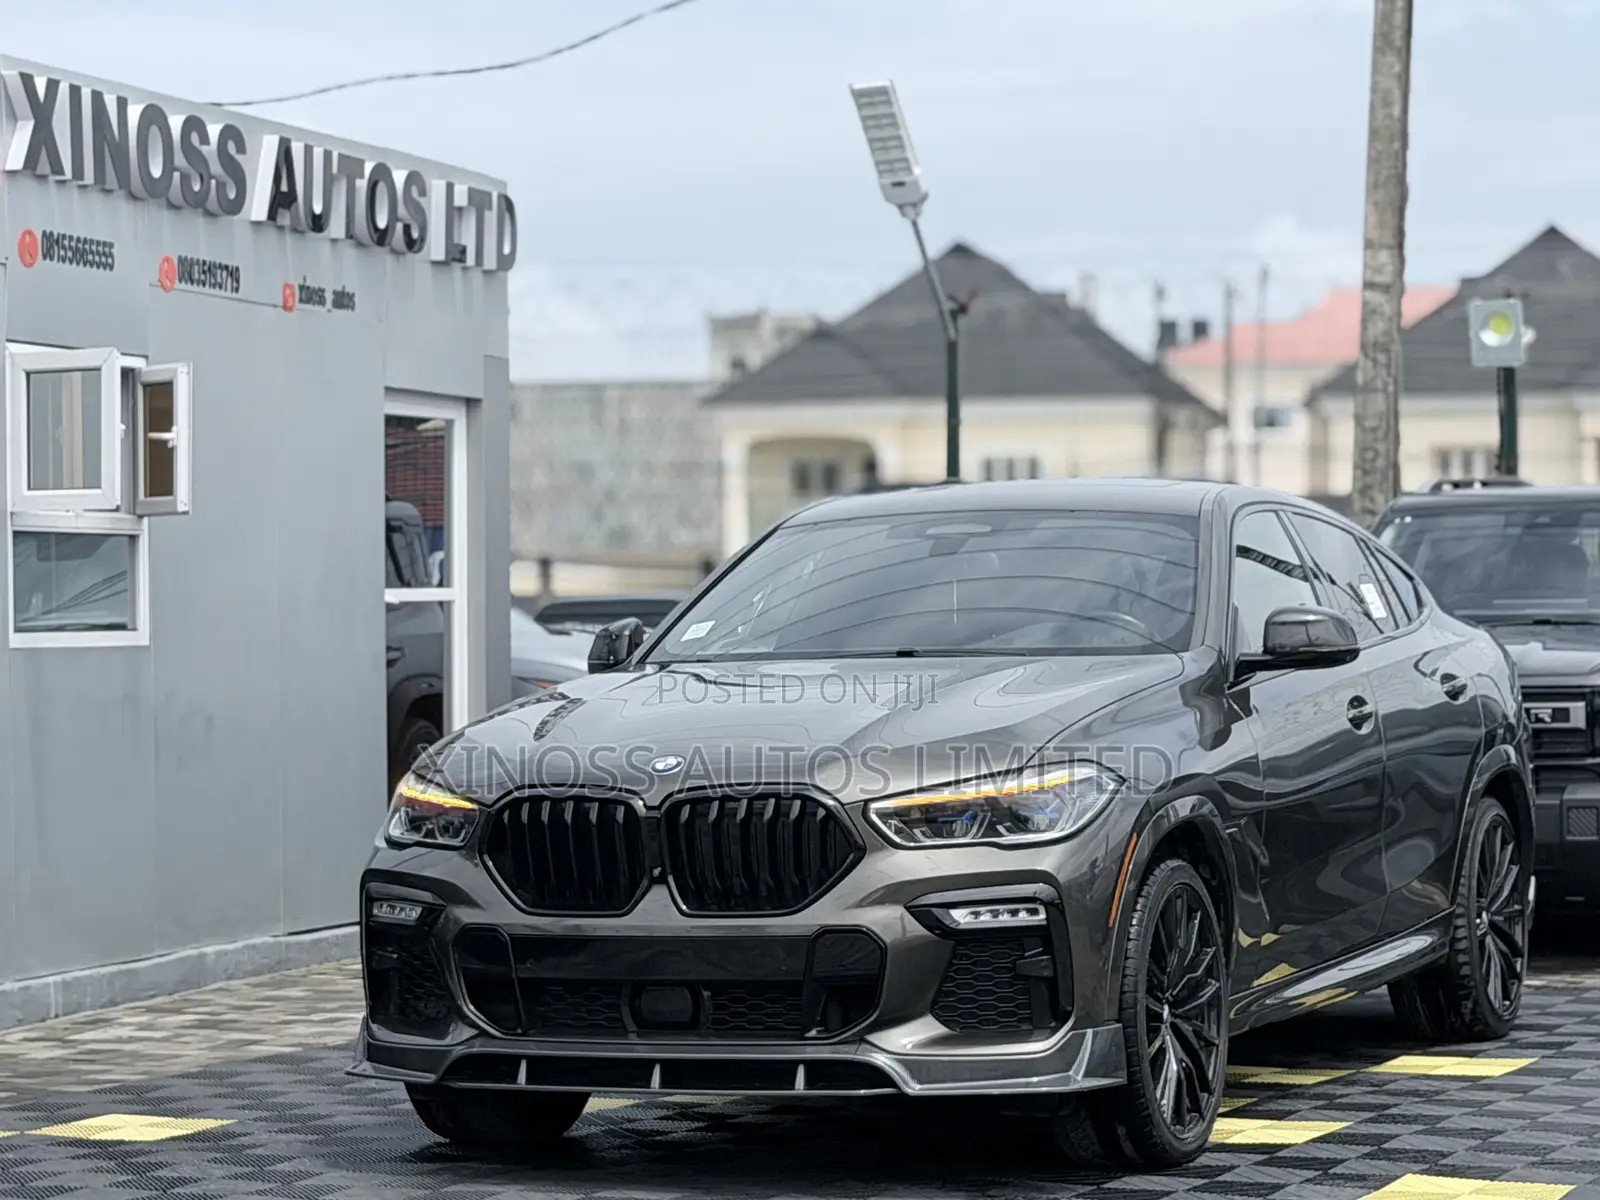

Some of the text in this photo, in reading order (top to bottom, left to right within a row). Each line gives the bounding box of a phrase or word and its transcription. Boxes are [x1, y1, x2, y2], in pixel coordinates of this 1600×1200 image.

[5, 70, 518, 272] XINOSS AUTOS LTD
[41, 229, 115, 272] 08155665555
